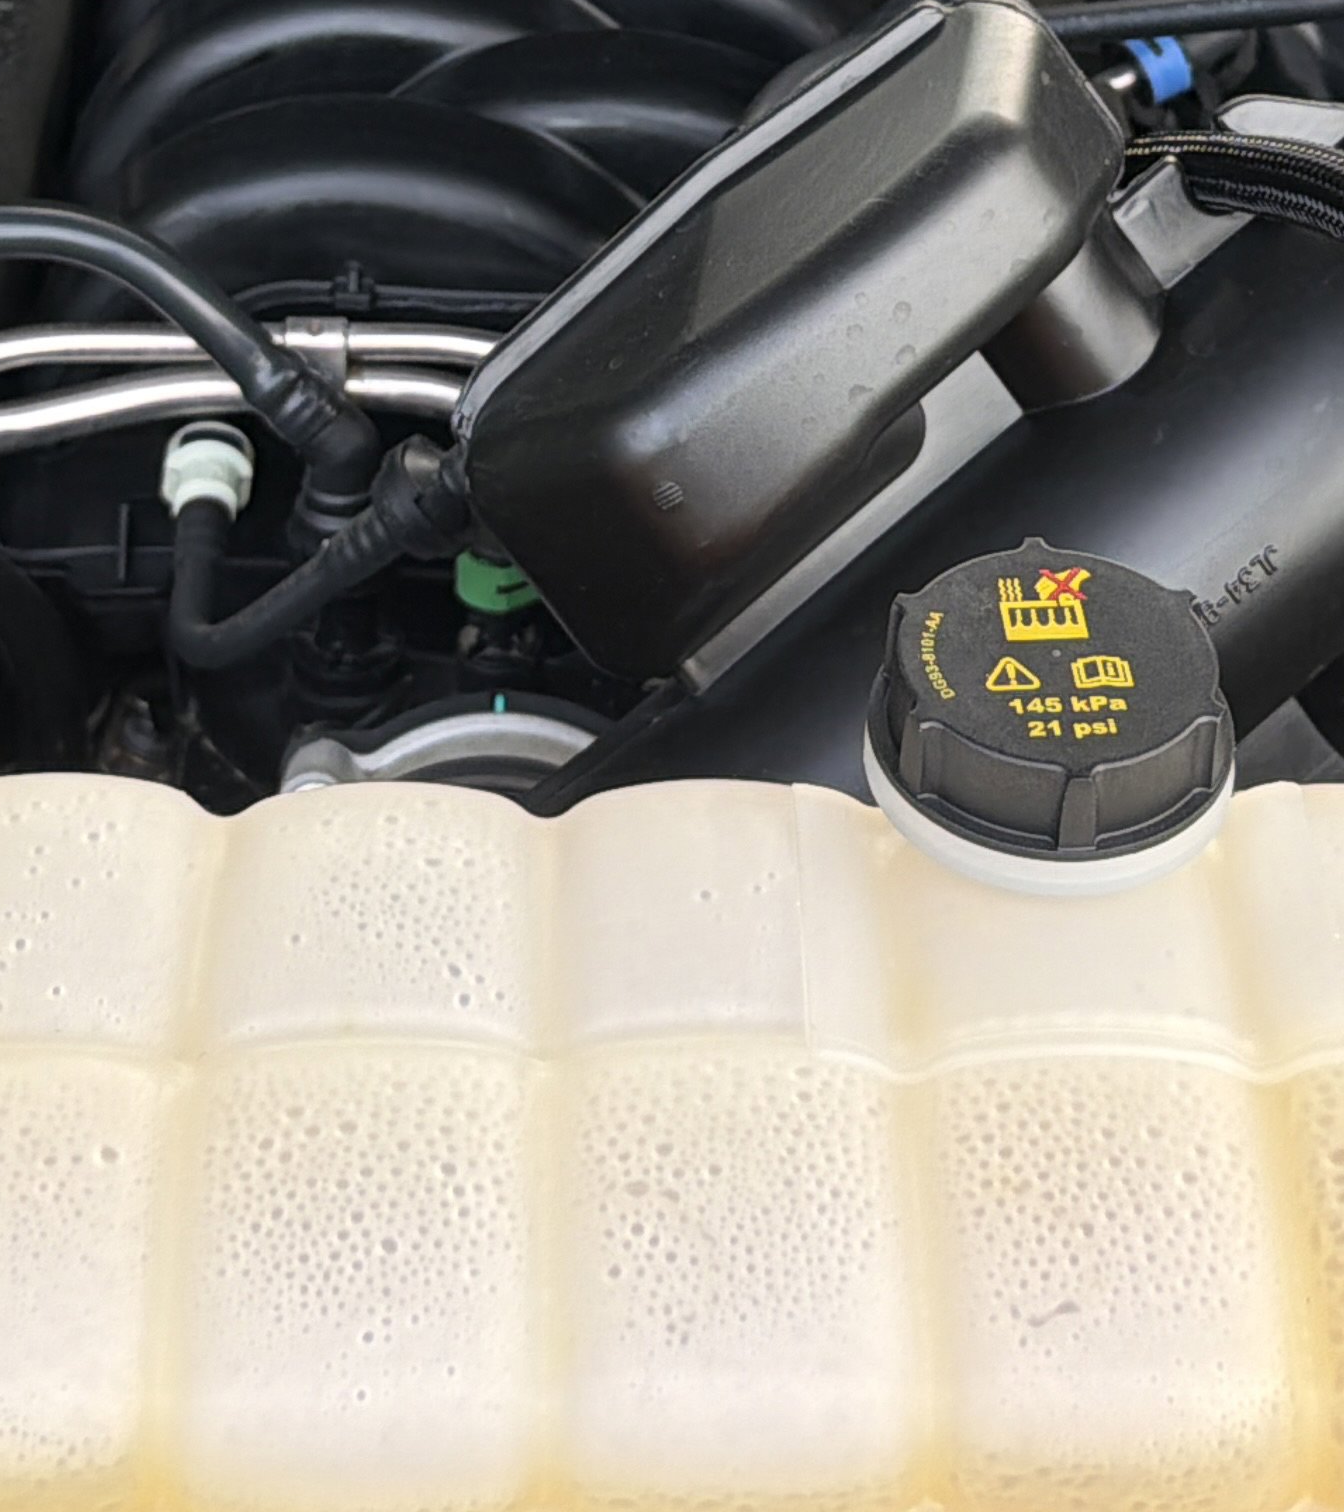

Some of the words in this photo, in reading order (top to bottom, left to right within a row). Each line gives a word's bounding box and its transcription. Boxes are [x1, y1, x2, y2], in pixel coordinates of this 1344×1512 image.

[1008, 697, 1063, 715] 145
[1072, 696, 1128, 713] kPa
[1027, 720, 1063, 738] 21
[1074, 718, 1118, 740] psi
